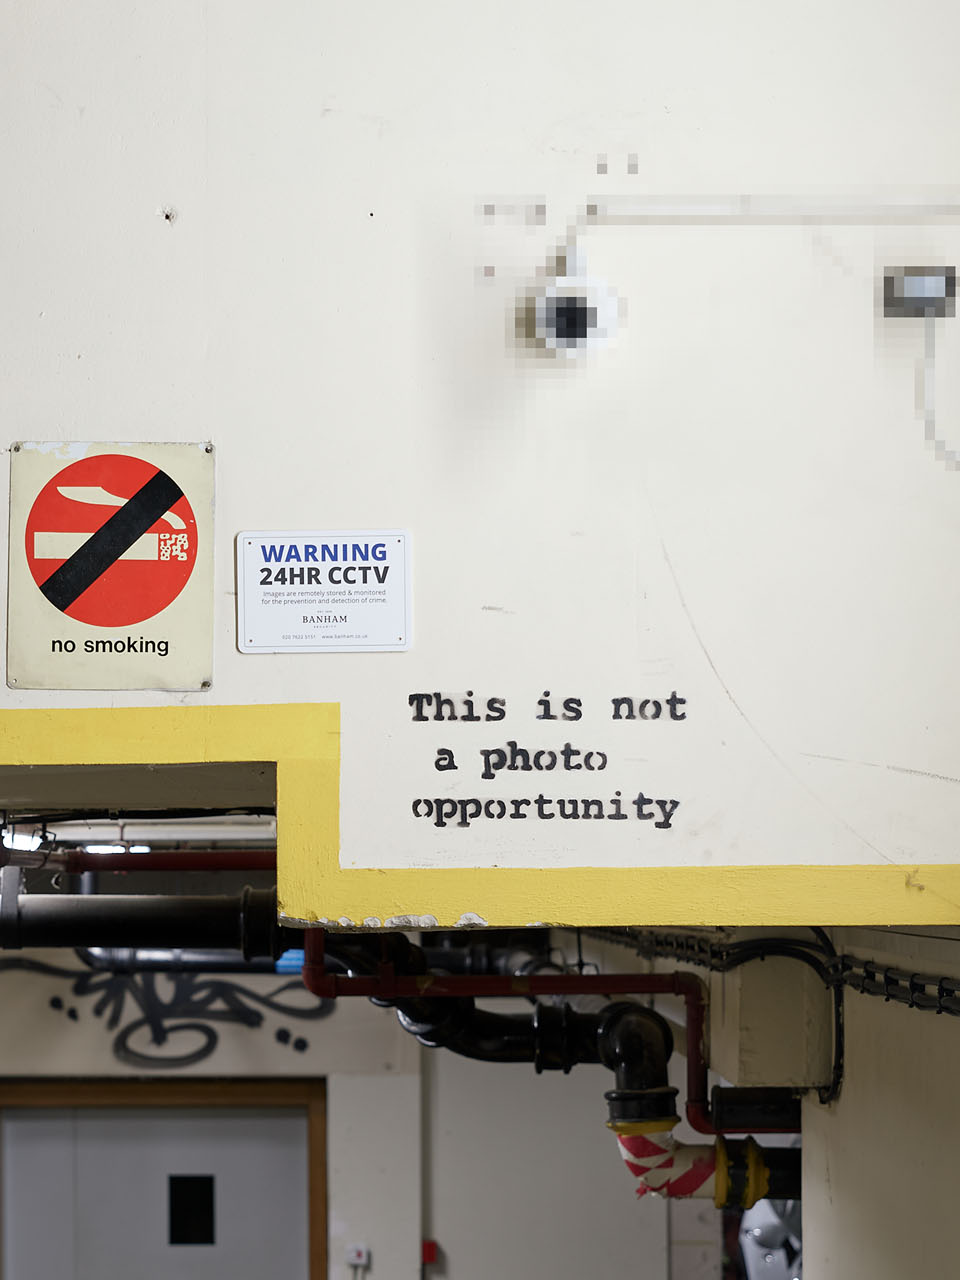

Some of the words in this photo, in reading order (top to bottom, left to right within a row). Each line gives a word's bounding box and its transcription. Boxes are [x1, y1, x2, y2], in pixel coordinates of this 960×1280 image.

[261, 543, 387, 563] WARNING
[259, 567, 322, 585] 24HR
[328, 566, 390, 585] CCTV
[298, 590, 325, 598] remotely
[302, 615, 348, 624] BANHAM
[52, 639, 76, 653] no
[84, 636, 169, 657] smoking
[408, 690, 506, 722] This
[536, 690, 583, 721] is
[611, 690, 687, 721] not
[434, 748, 458, 771] a
[480, 741, 608, 780] photo
[411, 790, 680, 829] opportunity
